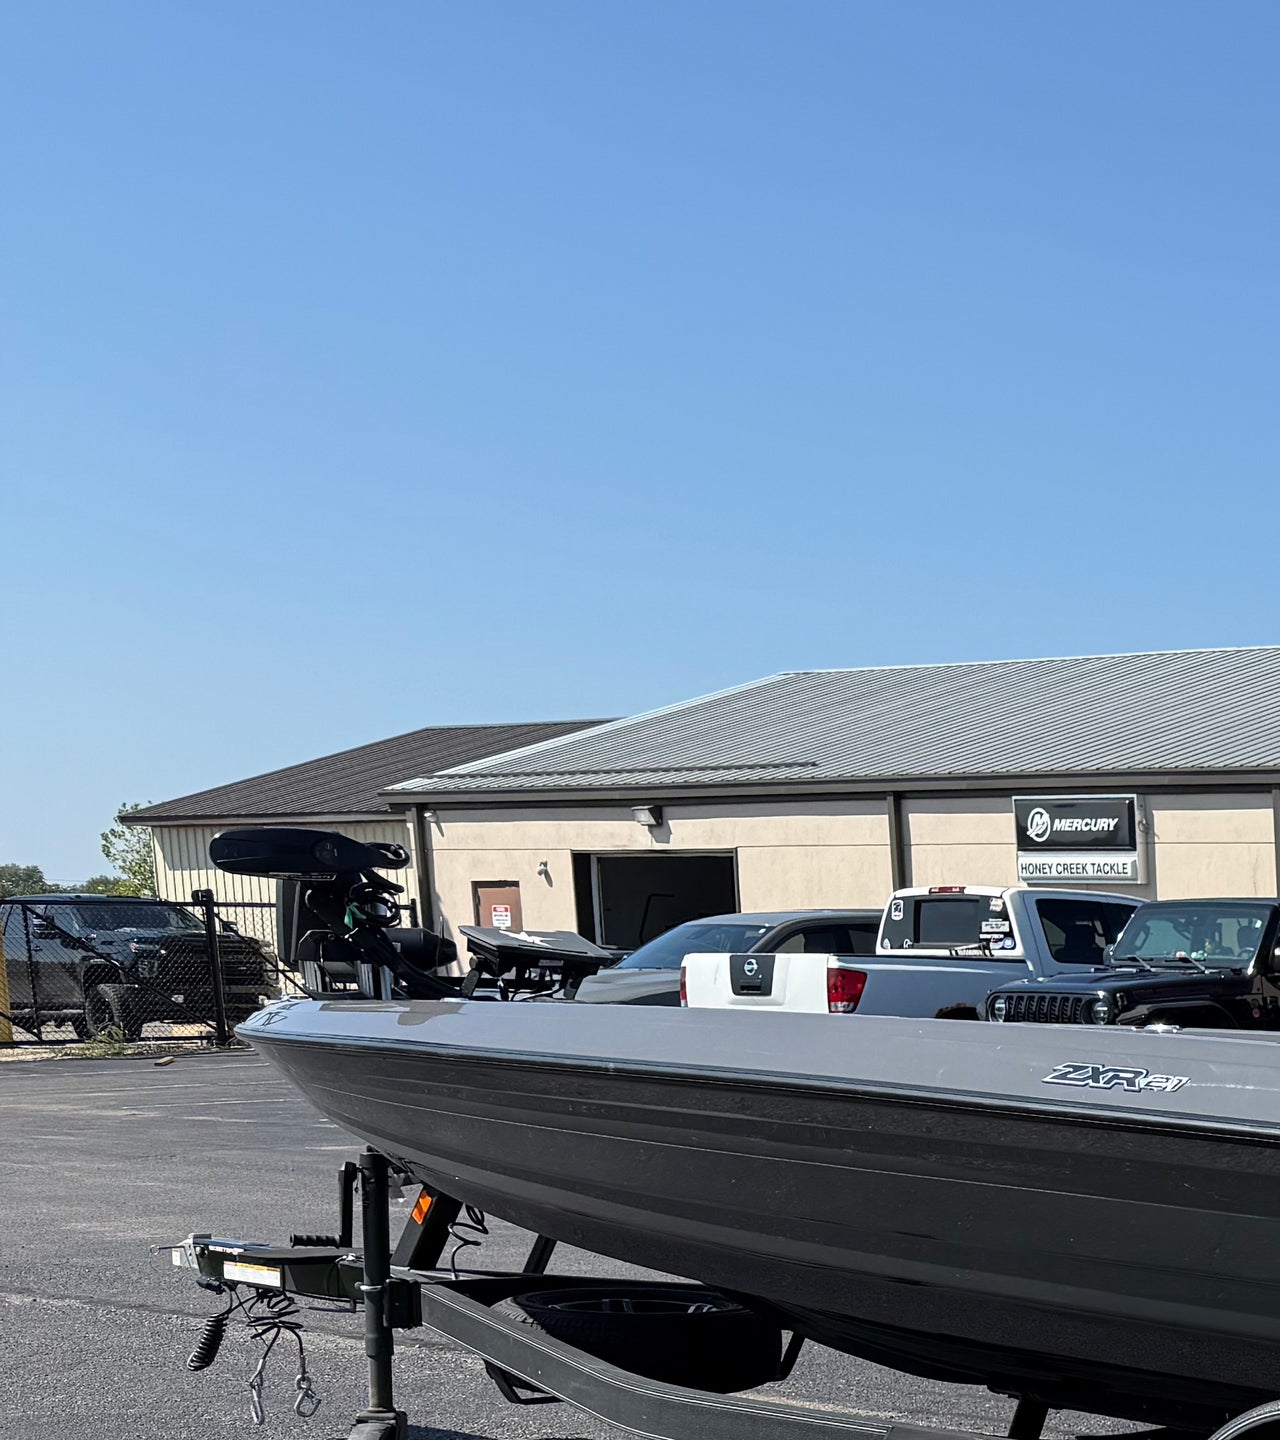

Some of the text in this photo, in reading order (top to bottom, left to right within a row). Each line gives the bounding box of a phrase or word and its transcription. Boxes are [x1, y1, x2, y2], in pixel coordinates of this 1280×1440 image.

[1052, 818, 1119, 832] MERCURY
[1021, 863, 1128, 875] HONEY CREEK TACKLE
[1042, 1061, 1191, 1093] ZXR 21
